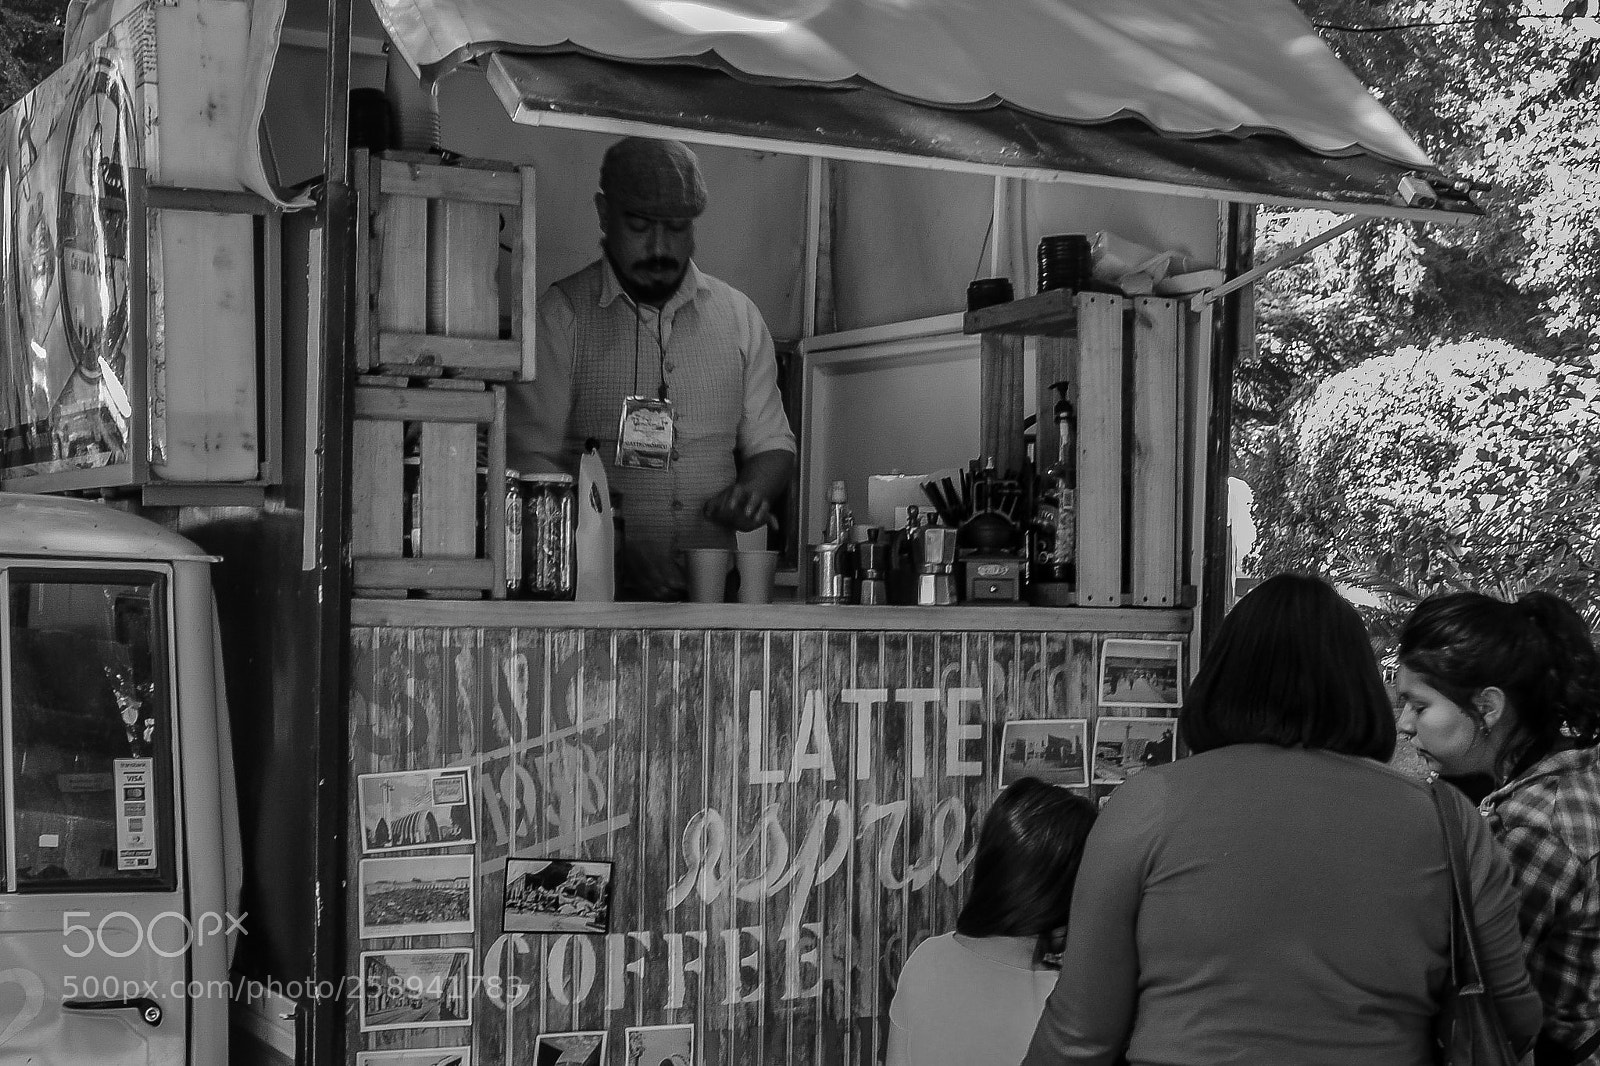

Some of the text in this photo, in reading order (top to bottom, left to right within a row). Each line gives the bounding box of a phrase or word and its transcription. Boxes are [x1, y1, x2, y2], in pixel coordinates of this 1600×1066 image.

[748, 687, 983, 785] LATTE
[666, 796, 977, 942] espre
[483, 922, 822, 1010] COFFEE
